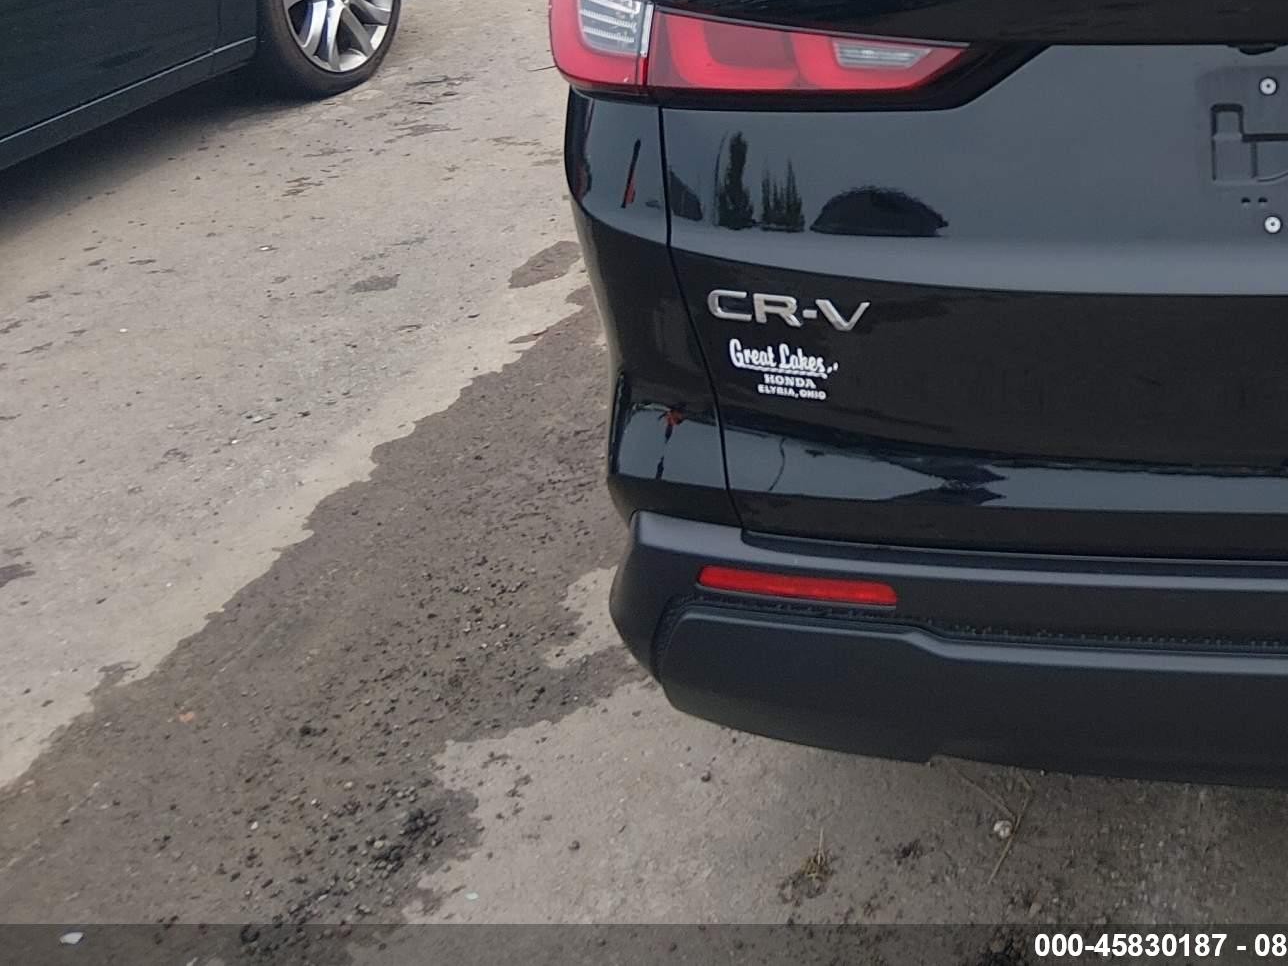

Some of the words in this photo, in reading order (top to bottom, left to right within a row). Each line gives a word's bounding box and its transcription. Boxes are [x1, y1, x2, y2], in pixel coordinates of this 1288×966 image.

[707, 289, 870, 331] CR-V
[729, 338, 777, 368] Great
[779, 343, 826, 373] Lakes
[764, 373, 817, 389] HONDA
[799, 389, 827, 400] OHIO
